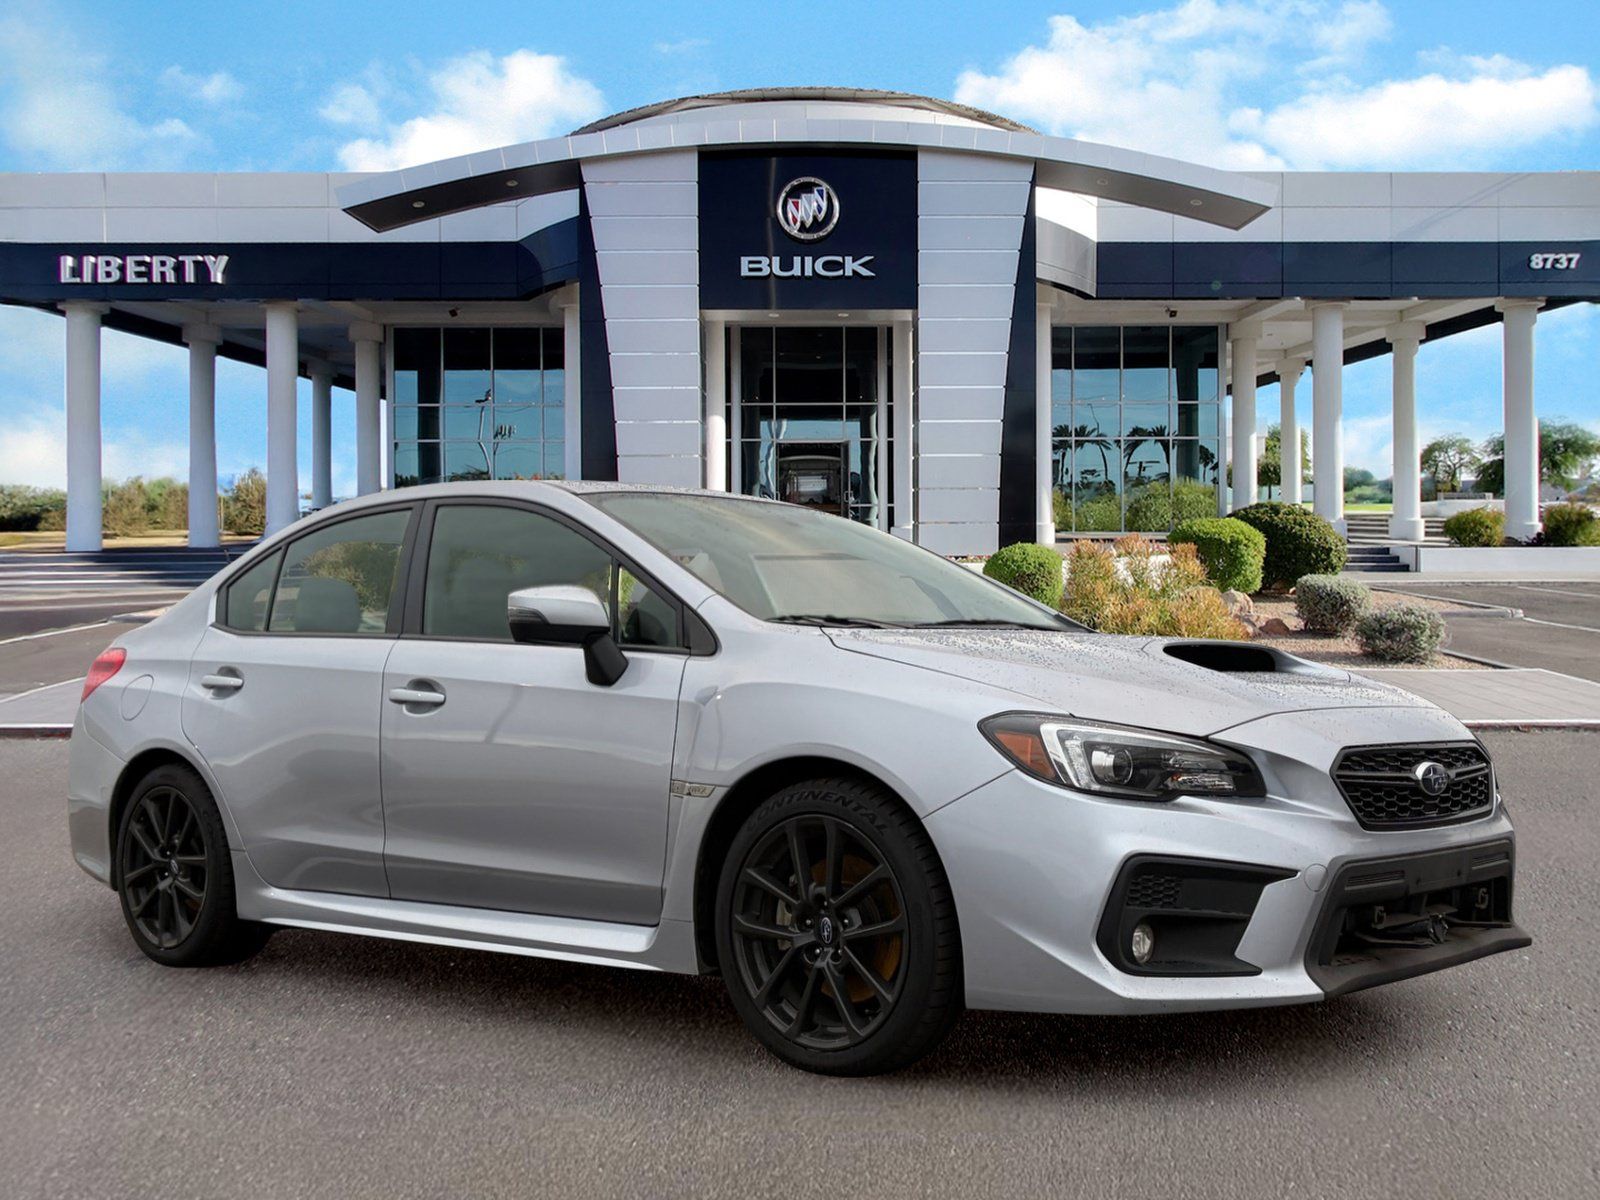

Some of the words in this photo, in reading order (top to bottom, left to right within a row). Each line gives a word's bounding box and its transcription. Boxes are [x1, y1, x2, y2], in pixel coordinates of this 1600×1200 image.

[59, 254, 230, 284] LIBERTY
[740, 255, 876, 277] BUICK
[1529, 253, 1580, 269] 8737
